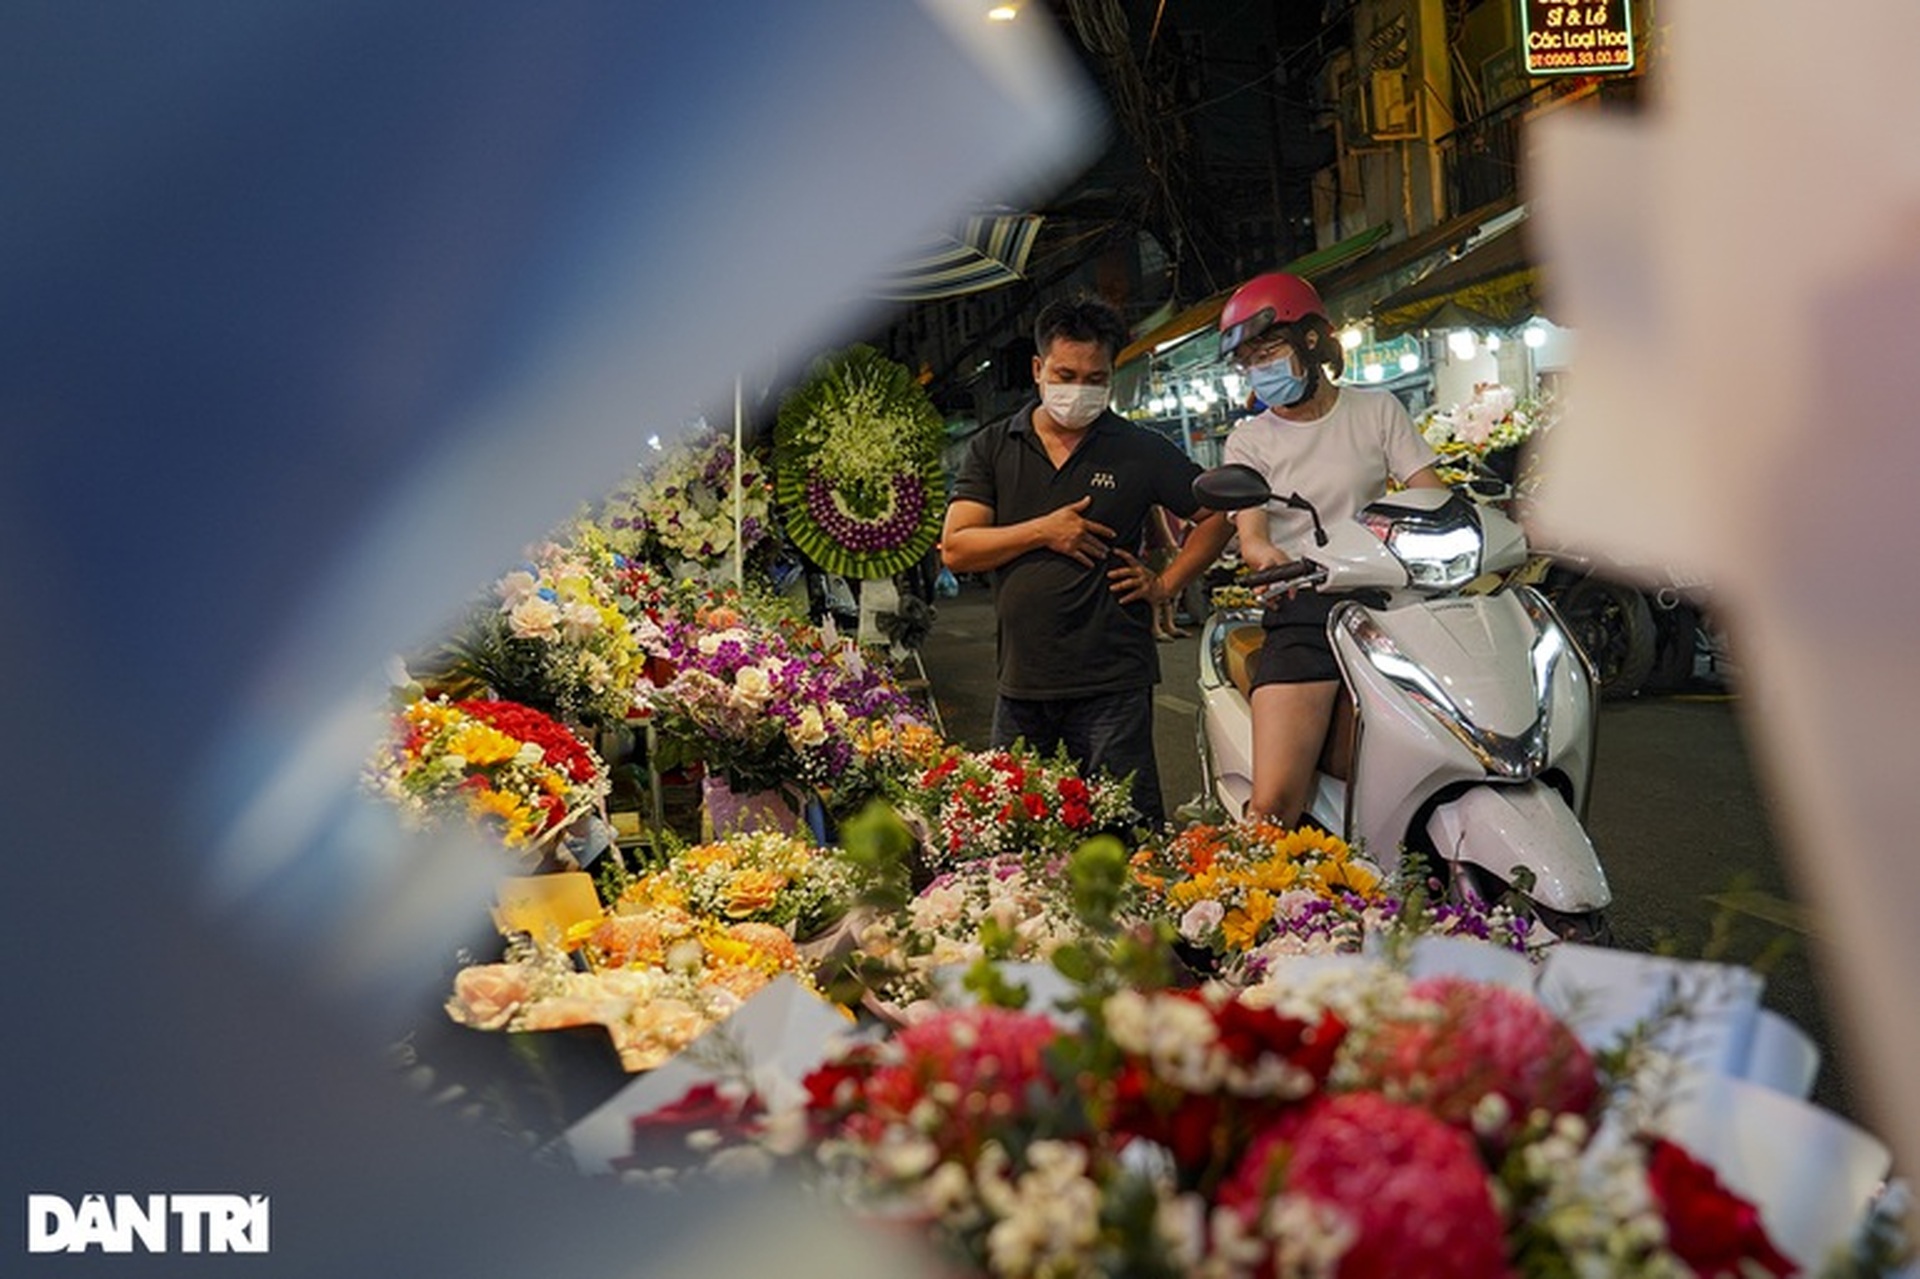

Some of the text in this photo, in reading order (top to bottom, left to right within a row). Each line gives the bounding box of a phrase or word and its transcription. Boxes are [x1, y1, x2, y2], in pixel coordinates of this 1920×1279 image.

[1566, 9, 1581, 26] &
[1529, 29, 1628, 50] Các Loại Hoa
